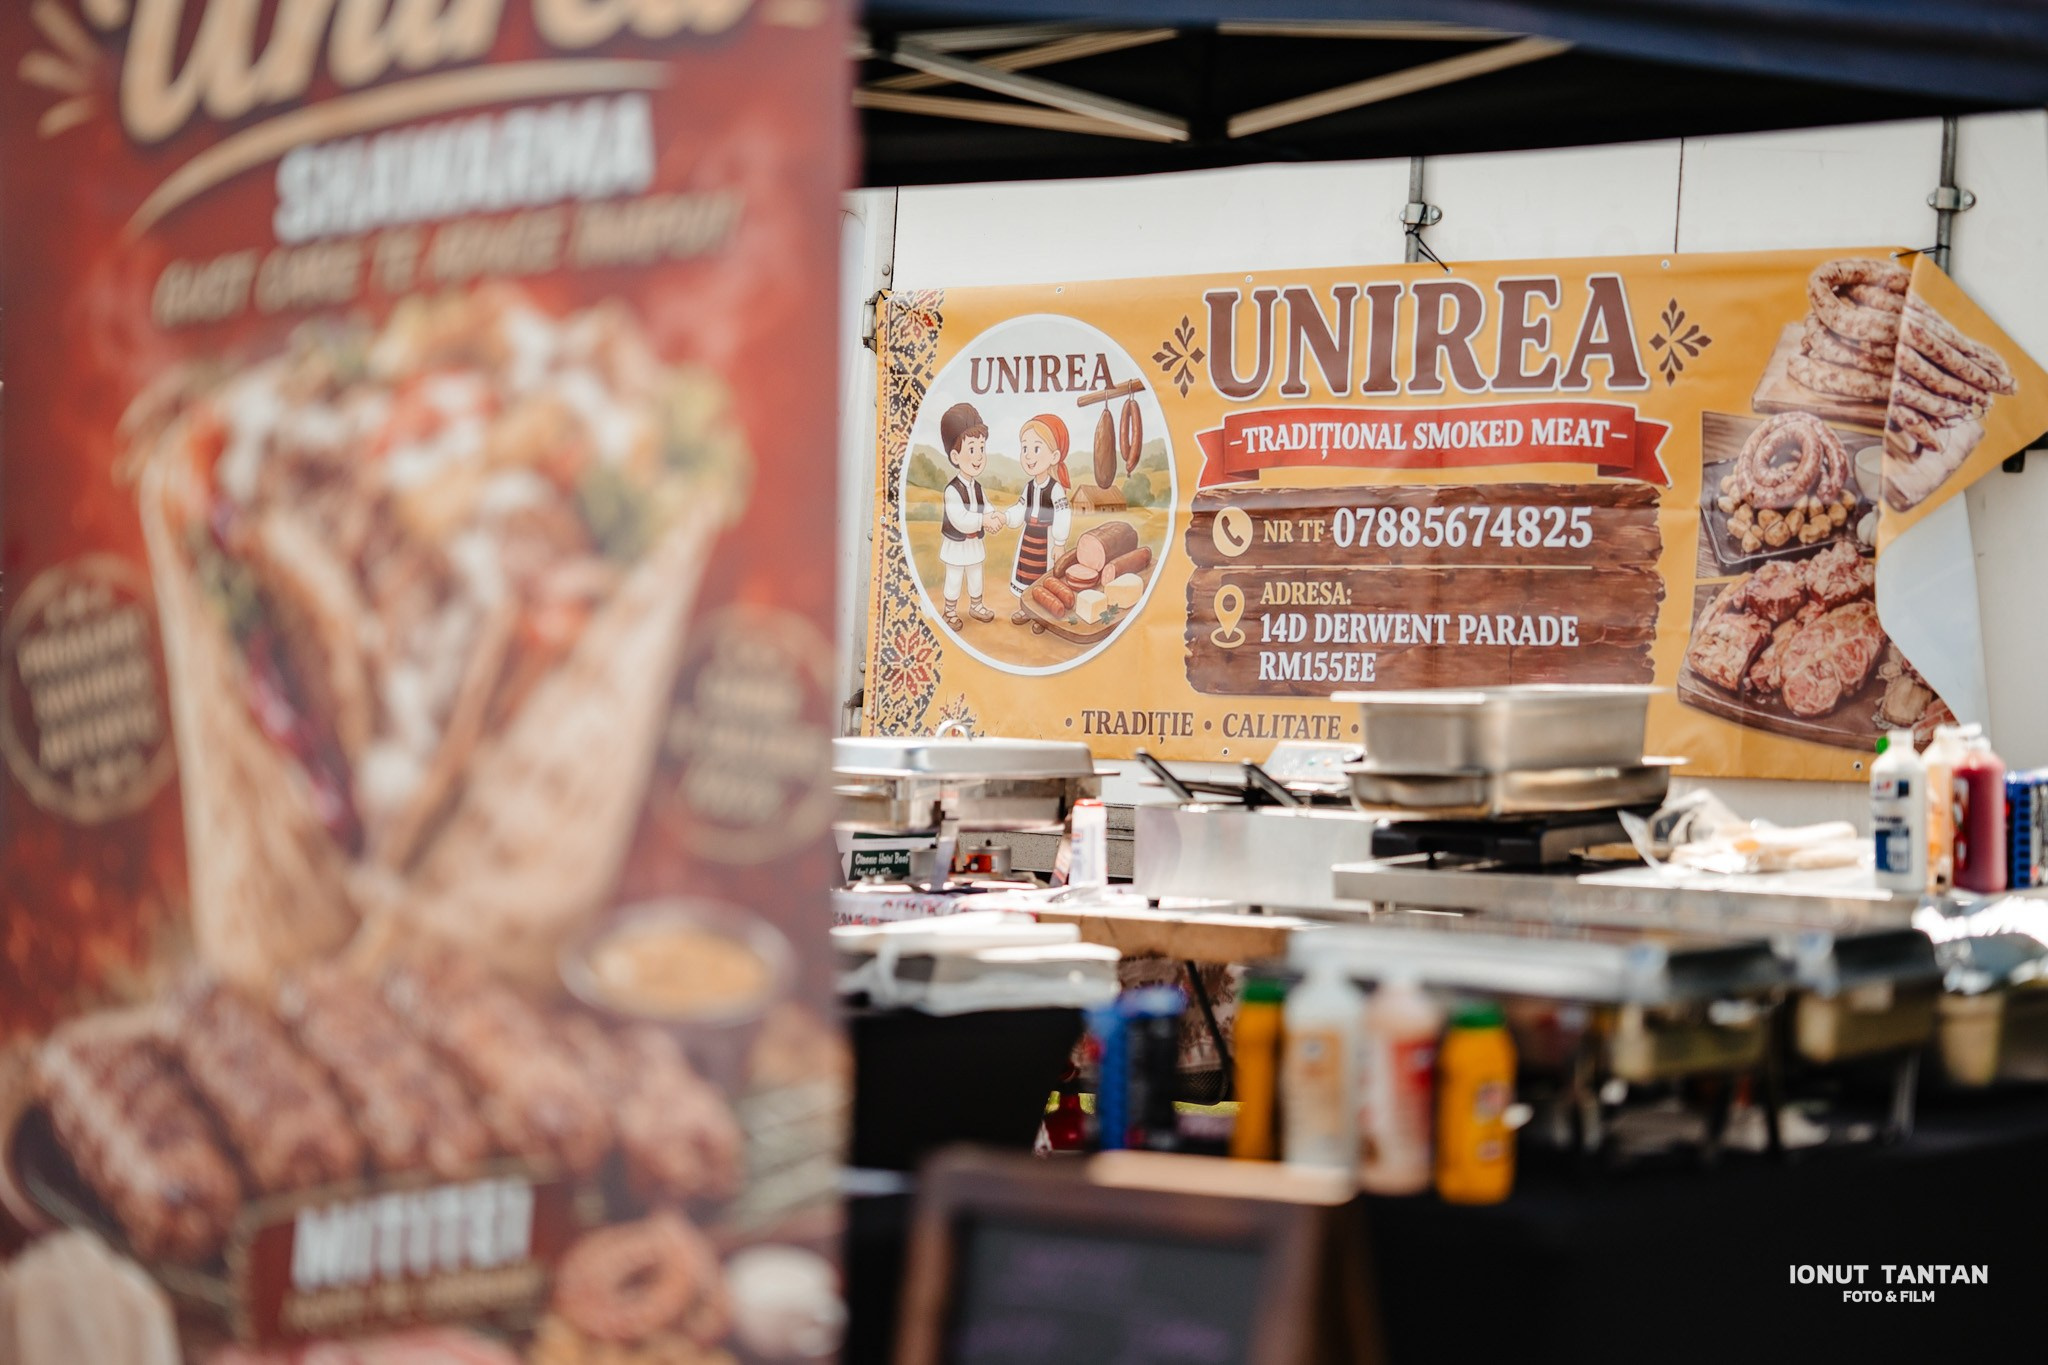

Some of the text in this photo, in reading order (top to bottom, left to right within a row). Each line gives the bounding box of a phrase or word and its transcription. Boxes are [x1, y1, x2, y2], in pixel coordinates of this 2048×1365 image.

[1204, 274, 1650, 401] UNIREA
[970, 353, 1116, 395] UNIREA
[1412, 420, 1524, 450] SMOKED
[1263, 506, 1593, 548] NR TF 07885674825
[1259, 581, 1352, 606] ADRESA:
[1259, 613, 1580, 648] 14D DERWENT PARADE
[1258, 651, 1377, 683] RM155EE
[1222, 713, 1341, 740] CALITATE
